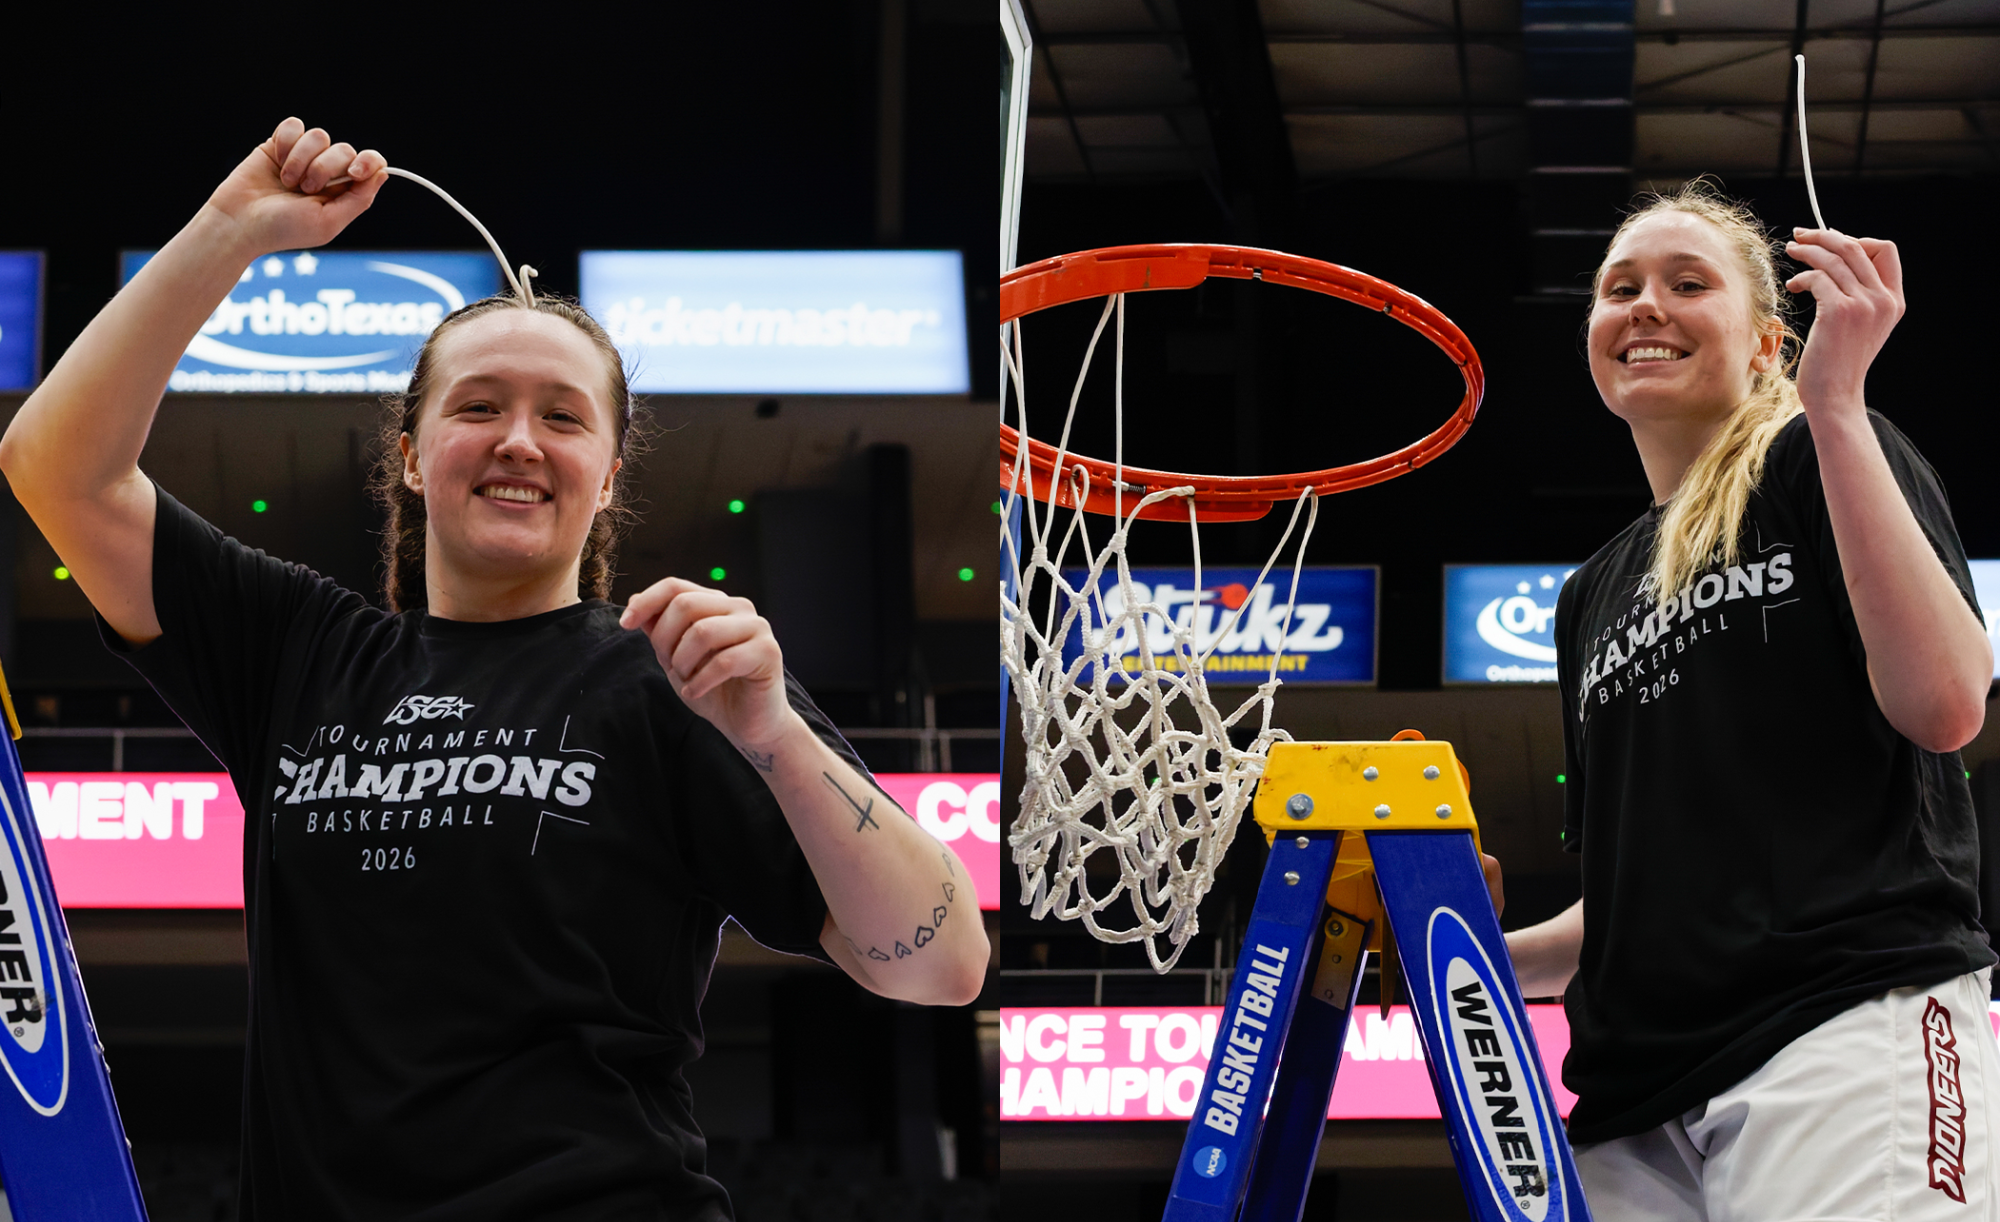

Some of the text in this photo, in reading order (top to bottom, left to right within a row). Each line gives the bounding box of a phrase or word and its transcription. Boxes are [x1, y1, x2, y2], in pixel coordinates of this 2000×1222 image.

[200, 288, 444, 336] OrthoTexas
[1121, 655, 1309, 673] ETEAINMENT
[1598, 613, 1729, 705] BASKETBALL
[1638, 668, 1680, 704] 2026
[319, 724, 538, 756] TOURNAMENT
[307, 805, 494, 833] BASKETBALL
[361, 847, 416, 871] 2026
[1204, 944, 1289, 1136] BASKETBALL
[1451, 981, 1546, 1198] WERNER
[1924, 998, 1965, 1203] PIONEERS
[1206, 1148, 1222, 1176] NCAA
